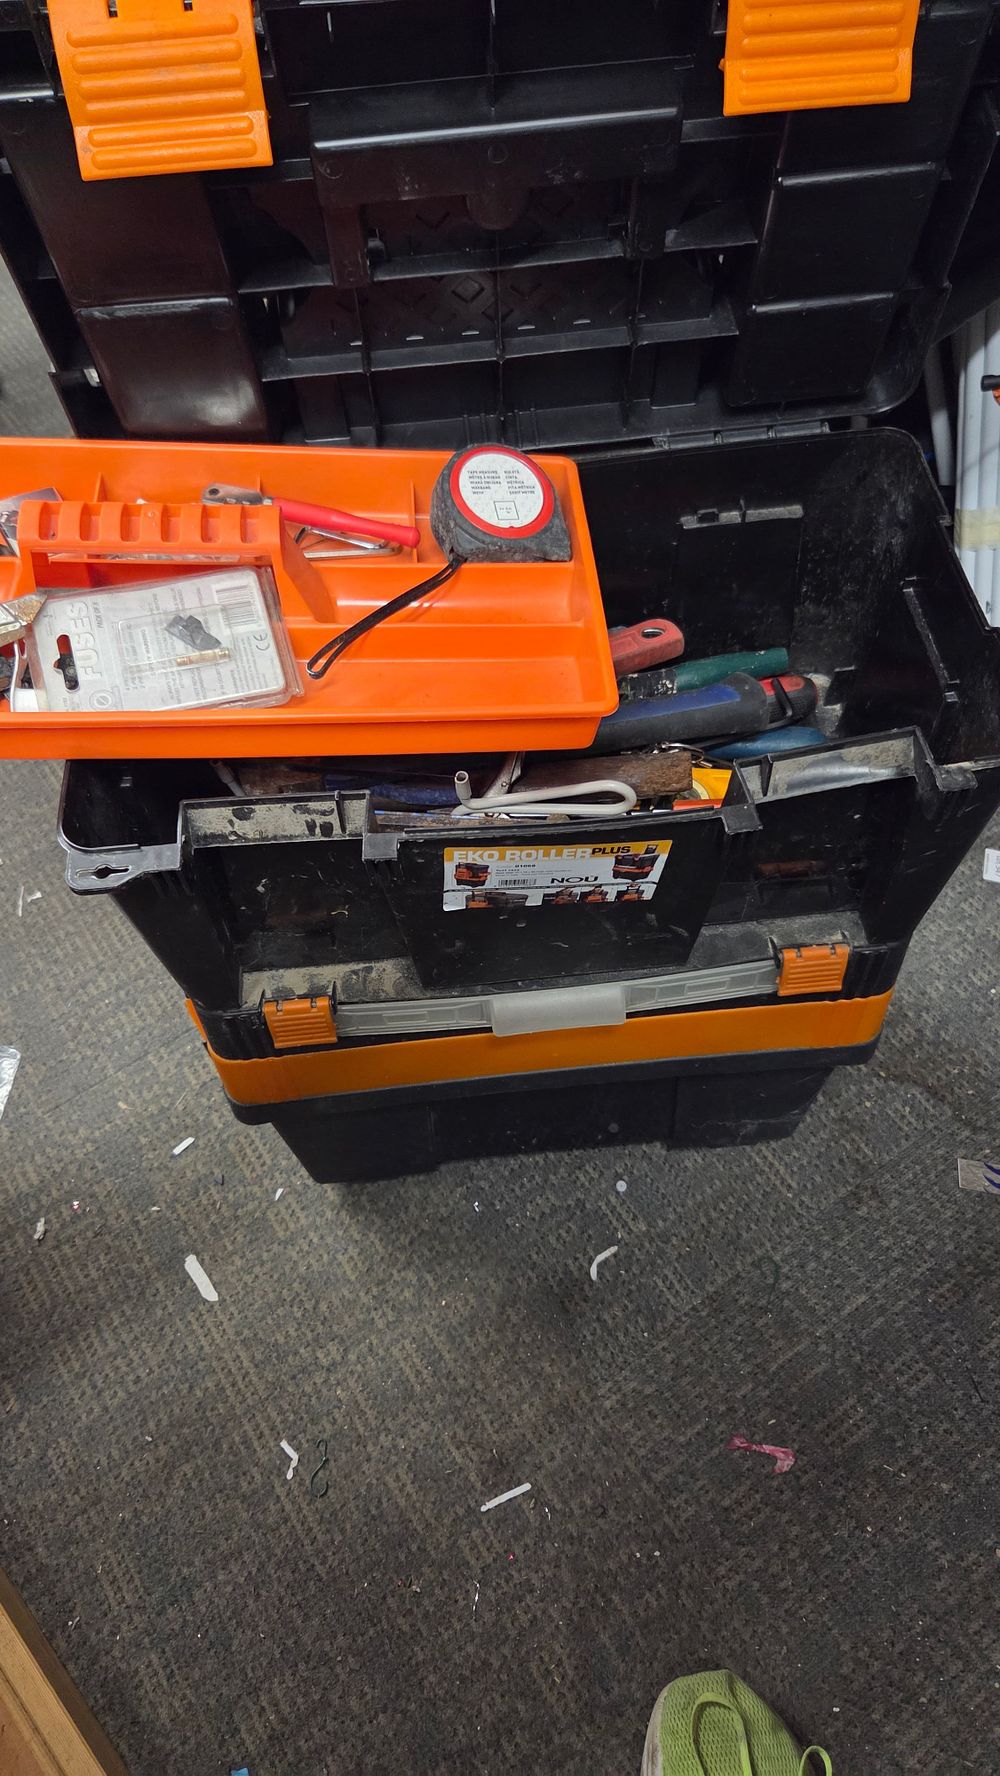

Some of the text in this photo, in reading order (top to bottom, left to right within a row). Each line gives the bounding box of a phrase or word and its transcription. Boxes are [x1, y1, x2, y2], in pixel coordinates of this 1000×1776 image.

[65, 601, 103, 681] FUSES
[453, 845, 631, 863] EKO ROLLER PLUS
